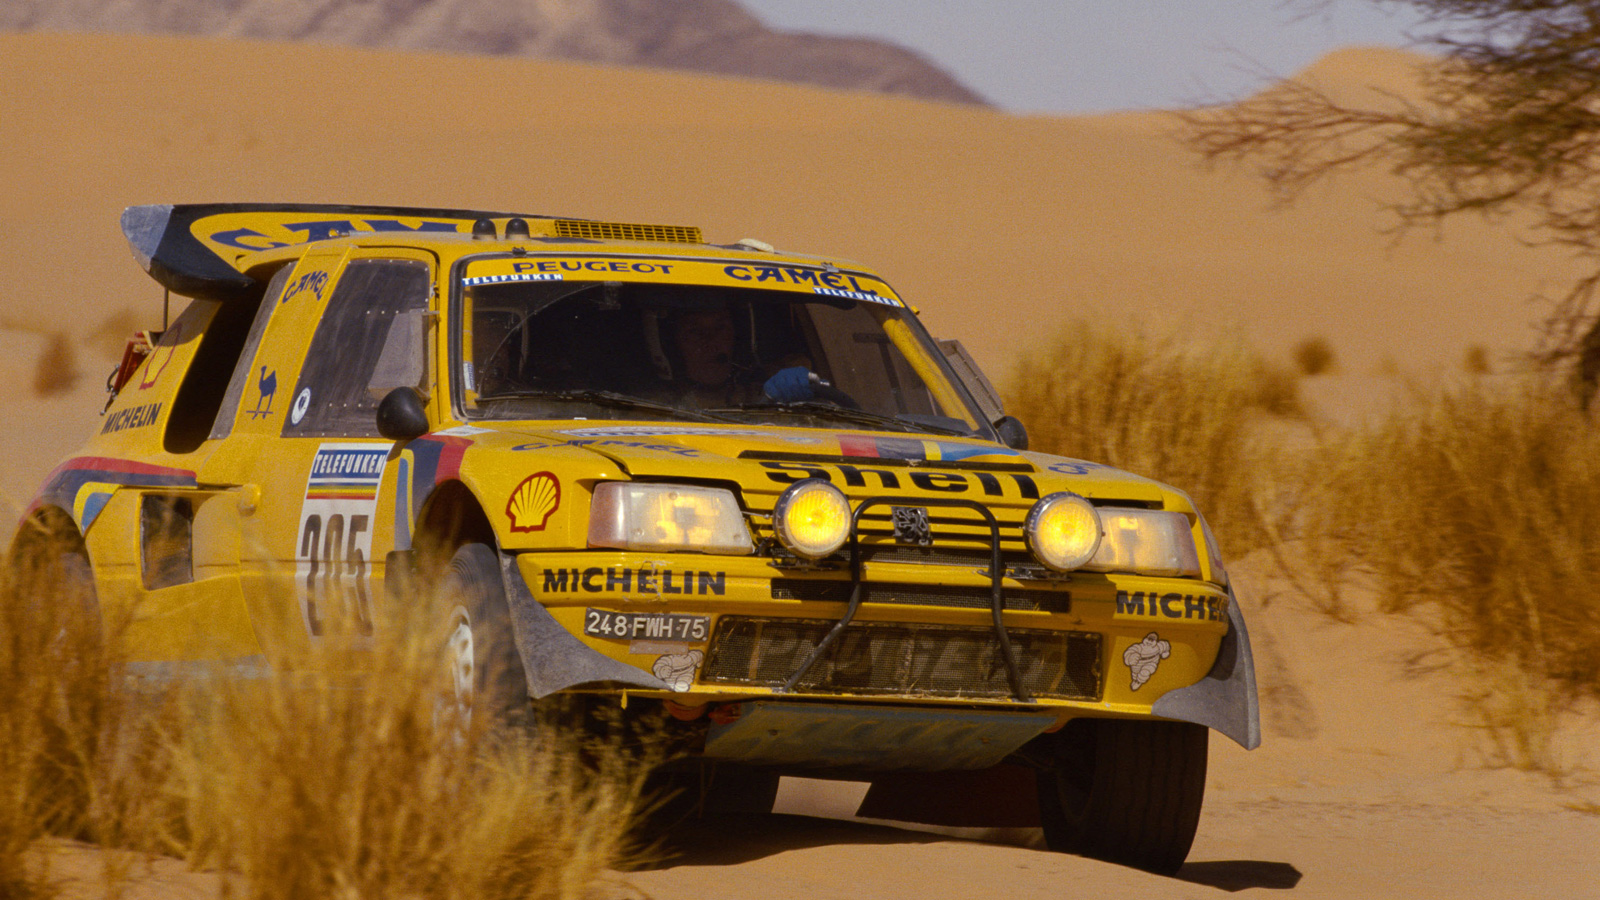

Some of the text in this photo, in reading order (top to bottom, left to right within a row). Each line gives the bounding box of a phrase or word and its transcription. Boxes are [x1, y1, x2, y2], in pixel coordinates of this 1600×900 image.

[462, 273, 563, 285] TELEFUNKEN
[513, 261, 673, 274] PEUGEOT
[723, 266, 878, 295] CAMEL
[282, 270, 329, 304] CAMEL
[814, 287, 900, 307] TELEFUNKEN
[101, 403, 163, 435] MICHELIN
[314, 454, 386, 474] TELEFUNKEN
[543, 567, 726, 596] MICHELIN
[587, 611, 705, 639] 248 FWH 75
